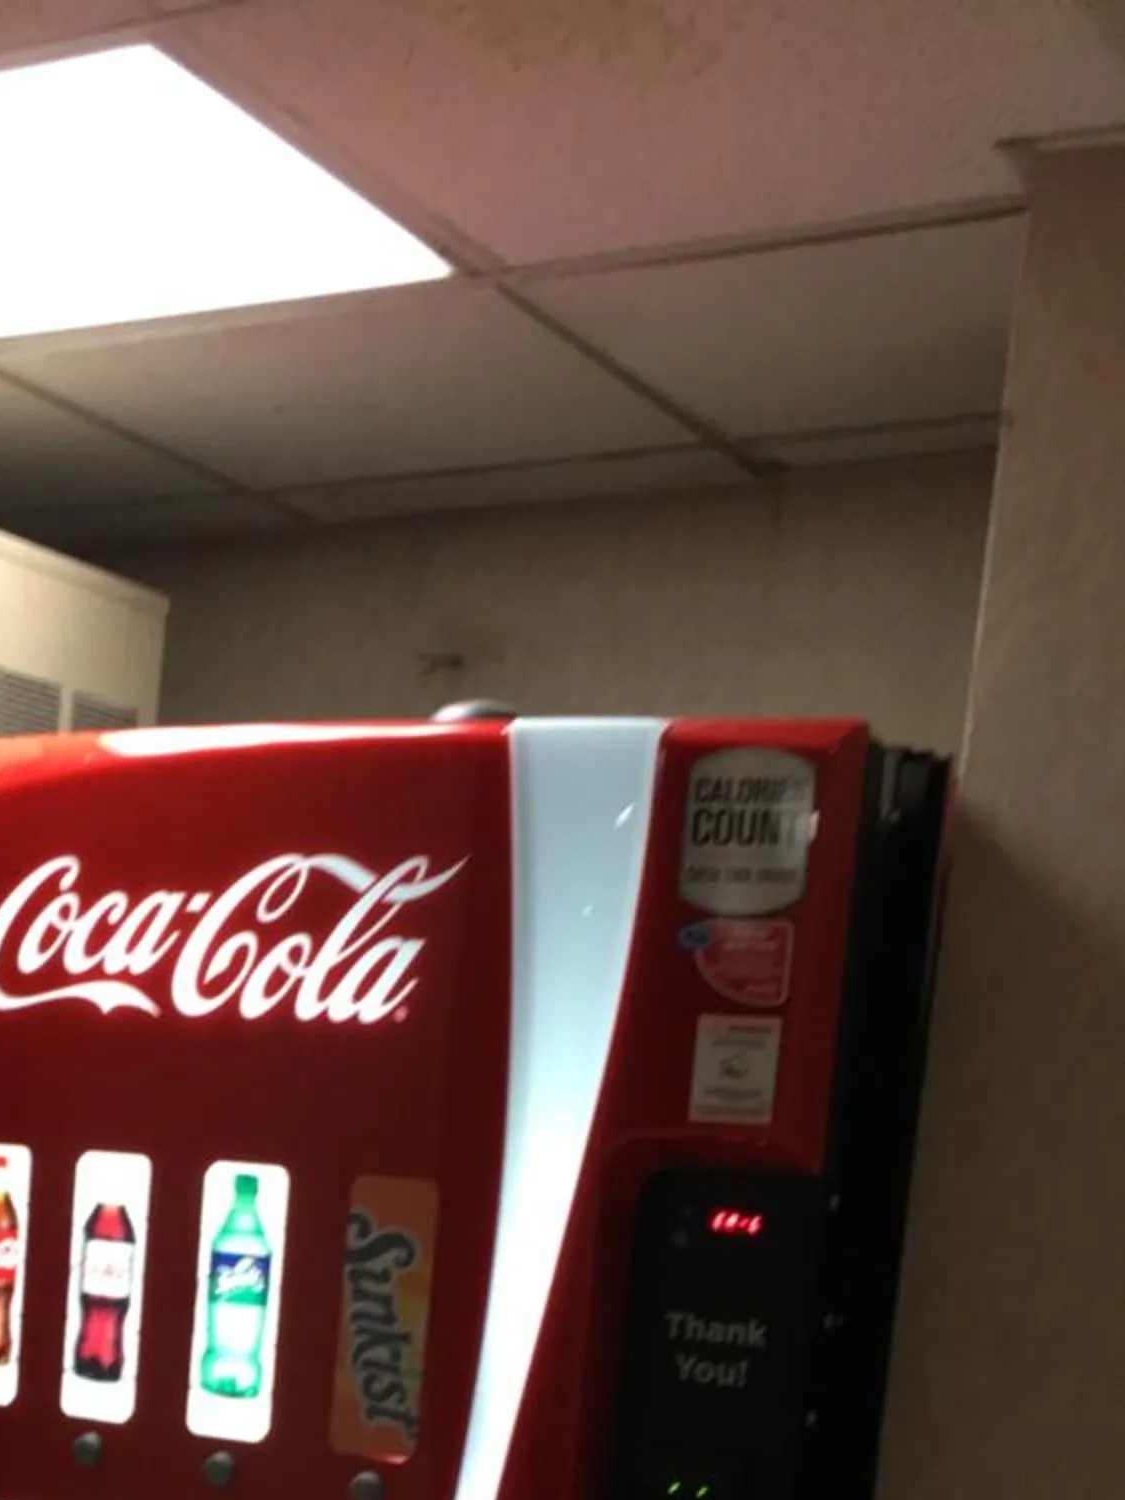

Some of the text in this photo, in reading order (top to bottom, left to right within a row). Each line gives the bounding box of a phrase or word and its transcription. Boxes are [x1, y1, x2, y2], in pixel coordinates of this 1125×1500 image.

[695, 776, 809, 805] CALORI
[343, 1208, 416, 1442] Sunkist
[664, 1310, 766, 1347] Thank
[676, 1353, 748, 1388] You!
